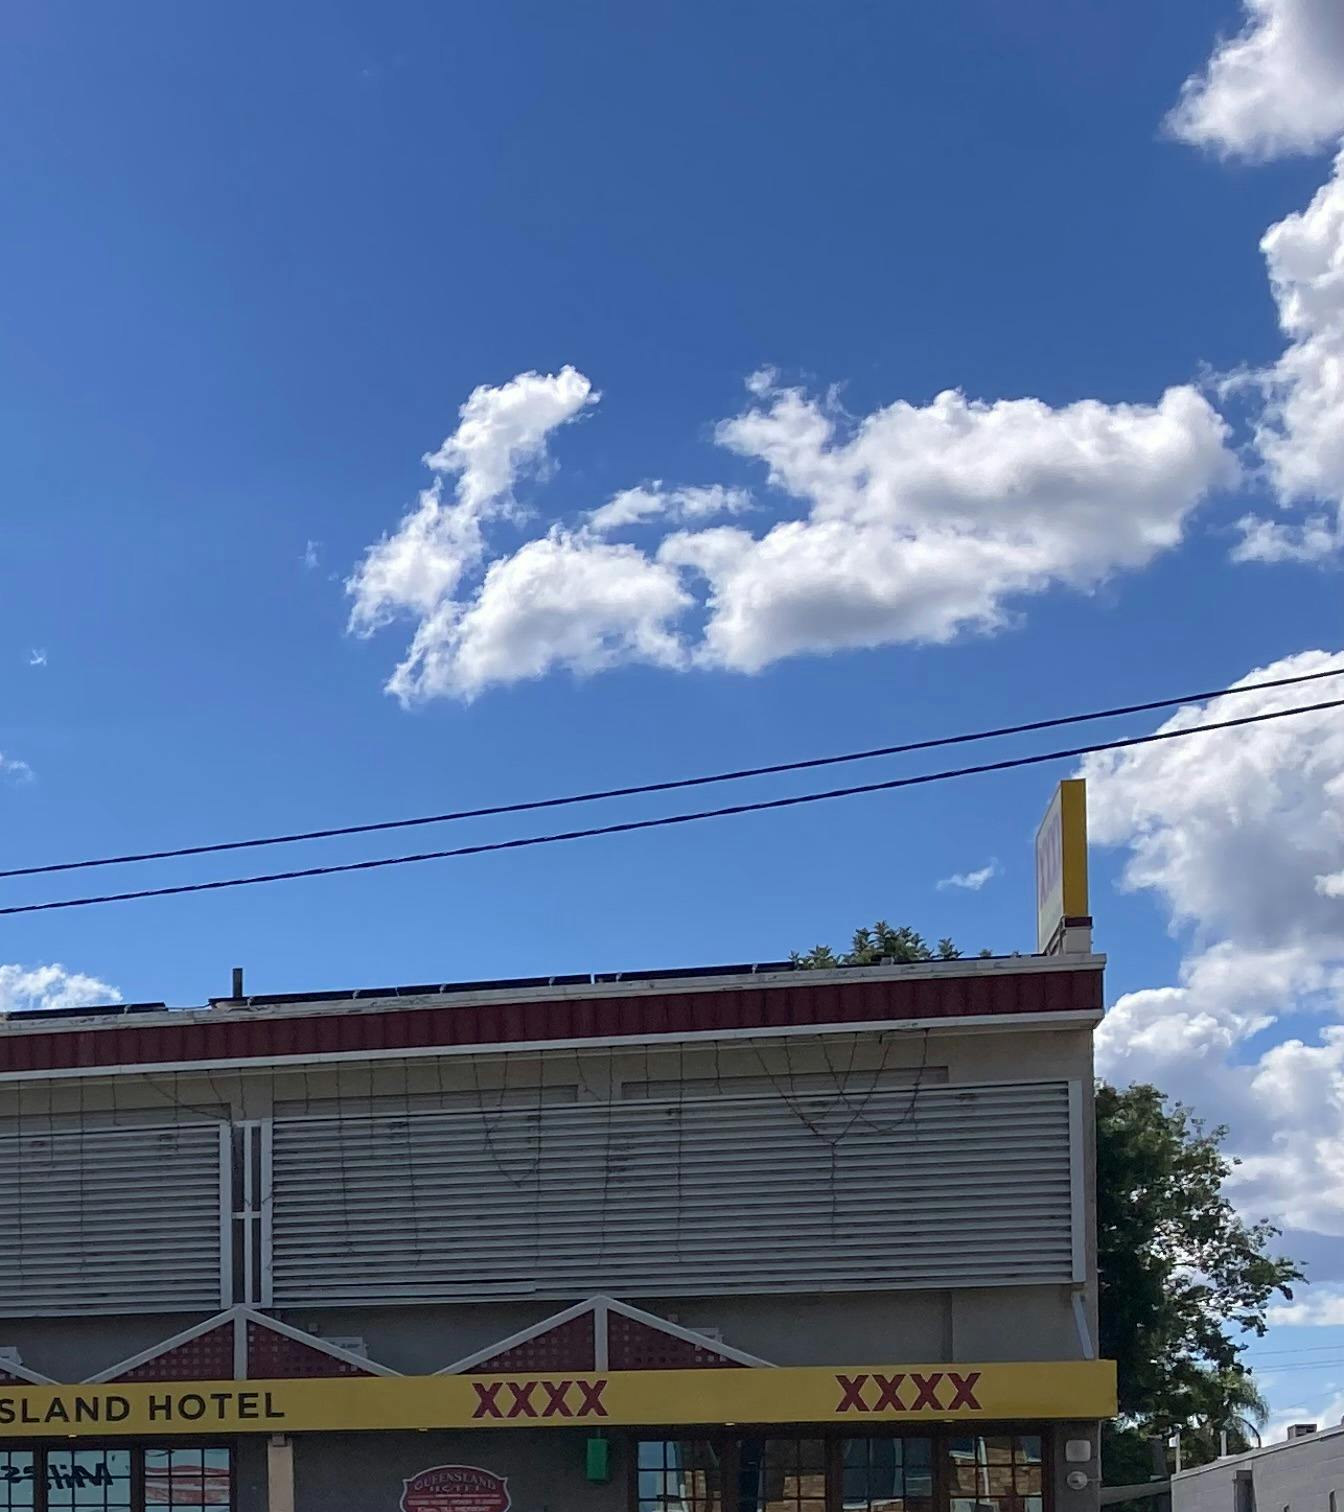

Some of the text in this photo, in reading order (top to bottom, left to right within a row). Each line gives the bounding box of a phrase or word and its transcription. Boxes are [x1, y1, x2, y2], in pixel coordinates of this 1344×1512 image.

[148, 1391, 285, 1421] HOTEL
[472, 1379, 609, 1419] XXXX
[834, 1372, 983, 1413] XXXX
[414, 1471, 497, 1491] QUEENSLAND
